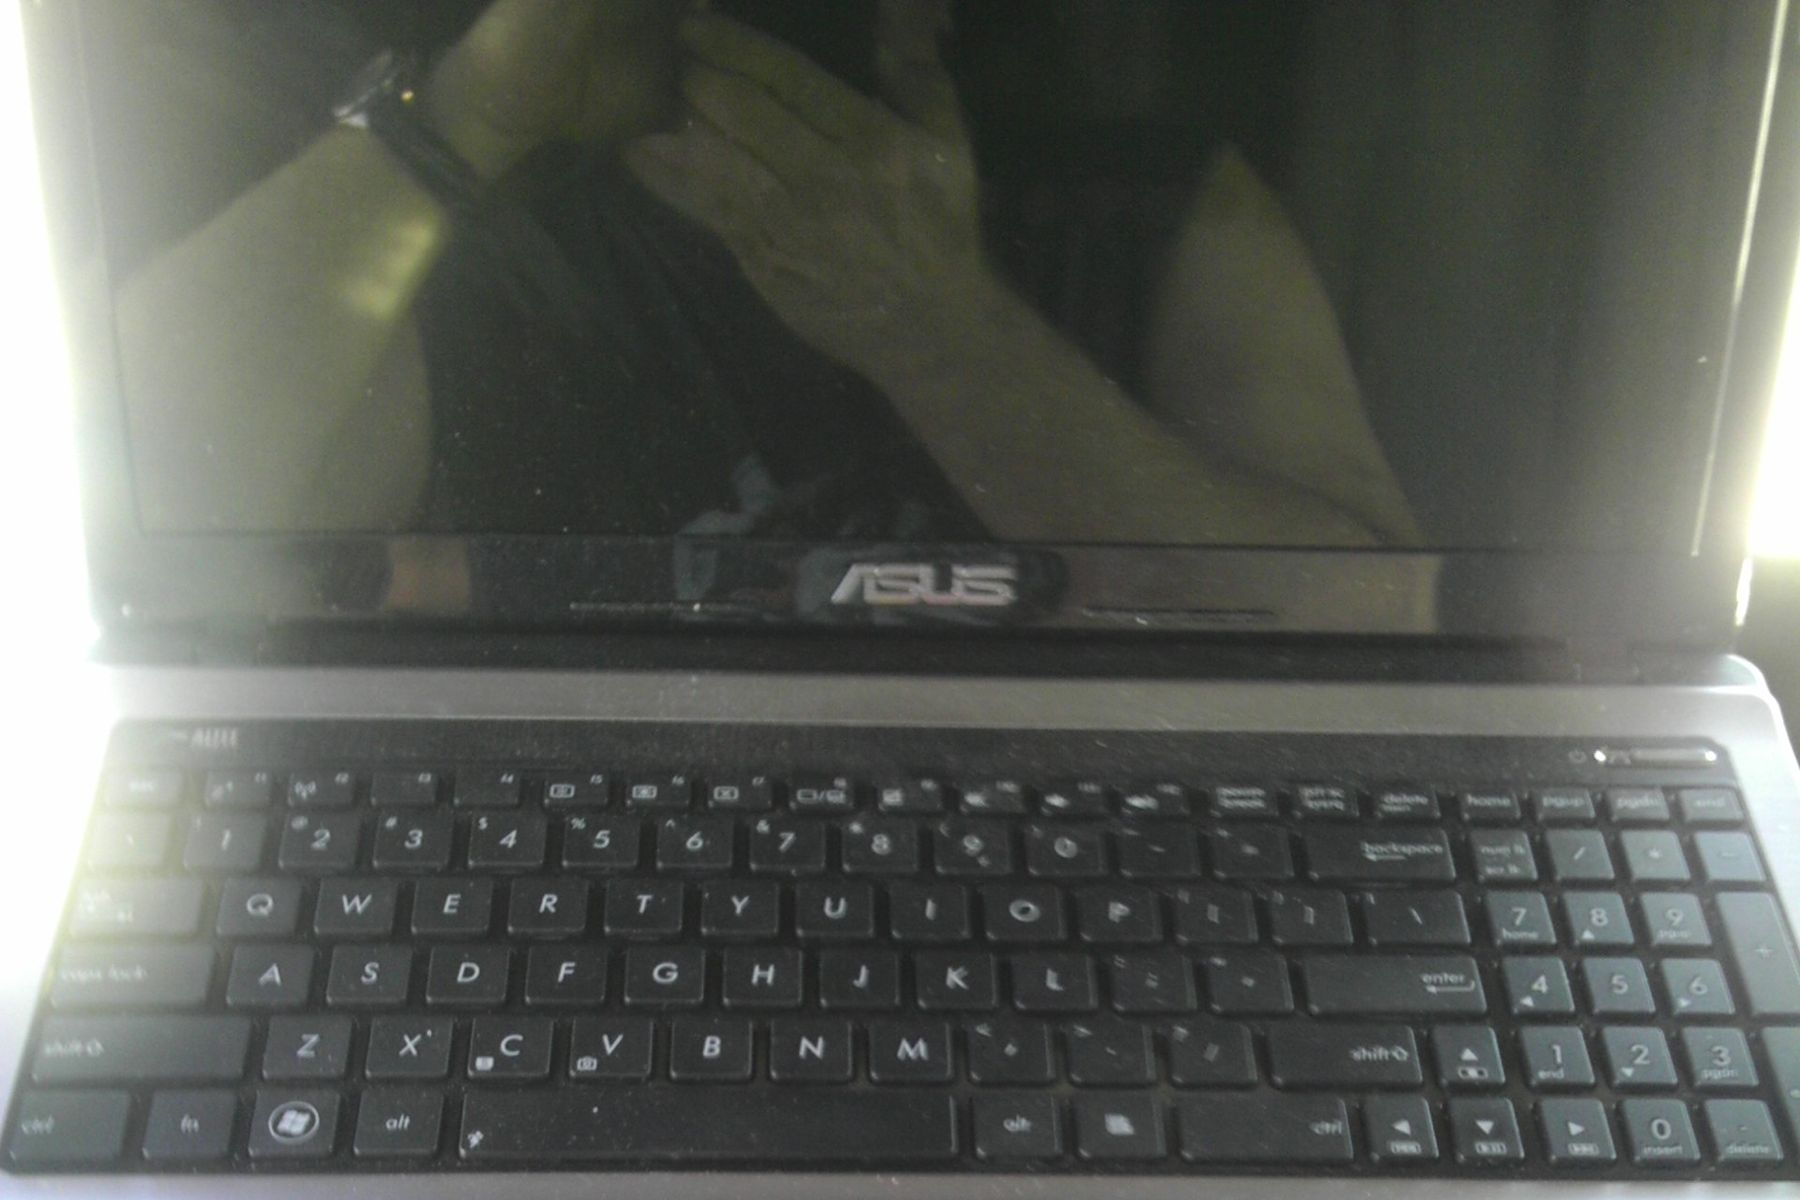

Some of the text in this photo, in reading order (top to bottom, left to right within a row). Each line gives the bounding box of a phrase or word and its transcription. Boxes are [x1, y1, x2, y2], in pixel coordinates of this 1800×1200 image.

[831, 563, 1018, 606] ASUS
[310, 829, 331, 851] 2
[404, 829, 424, 849] 3
[499, 829, 518, 849] 4
[593, 830, 611, 849] 5
[685, 831, 703, 851] 6
[778, 832, 796, 852] 7
[871, 833, 891, 855] 8
[1362, 842, 1444, 856] backspace
[245, 894, 274, 917] Q
[341, 894, 371, 915] W
[442, 893, 462, 915] E
[539, 894, 558, 914] R
[637, 895, 653, 914] T
[731, 896, 750, 915] Y
[823, 897, 847, 919] U
[1511, 908, 1528, 926] 7
[1589, 908, 1608, 927] 8
[1665, 908, 1685, 927] 9
[1502, 928, 1539, 940] home
[259, 963, 282, 986] A
[360, 961, 380, 984] S
[456, 961, 481, 983] D
[556, 962, 577, 983] F
[652, 962, 679, 983] G
[751, 964, 775, 986] H
[853, 964, 870, 988] J
[945, 965, 969, 990] K
[1421, 973, 1465, 984] enter
[1530, 974, 1549, 994] 4
[1610, 975, 1629, 994] 5
[1689, 975, 1708, 994] 6
[296, 1033, 320, 1058] Z
[398, 1034, 422, 1057] X
[500, 1033, 524, 1058] C
[601, 1033, 624, 1056] V
[702, 1035, 721, 1058] B
[798, 1036, 825, 1059] N
[897, 1037, 929, 1061] M
[1353, 1046, 1391, 1062] shift
[1551, 1044, 1562, 1064] 1
[1630, 1044, 1650, 1065] 2
[1711, 1045, 1731, 1065] 3
[1538, 1067, 1565, 1080] end
[385, 1115, 411, 1130] alt
[1650, 1118, 1672, 1140] 0
